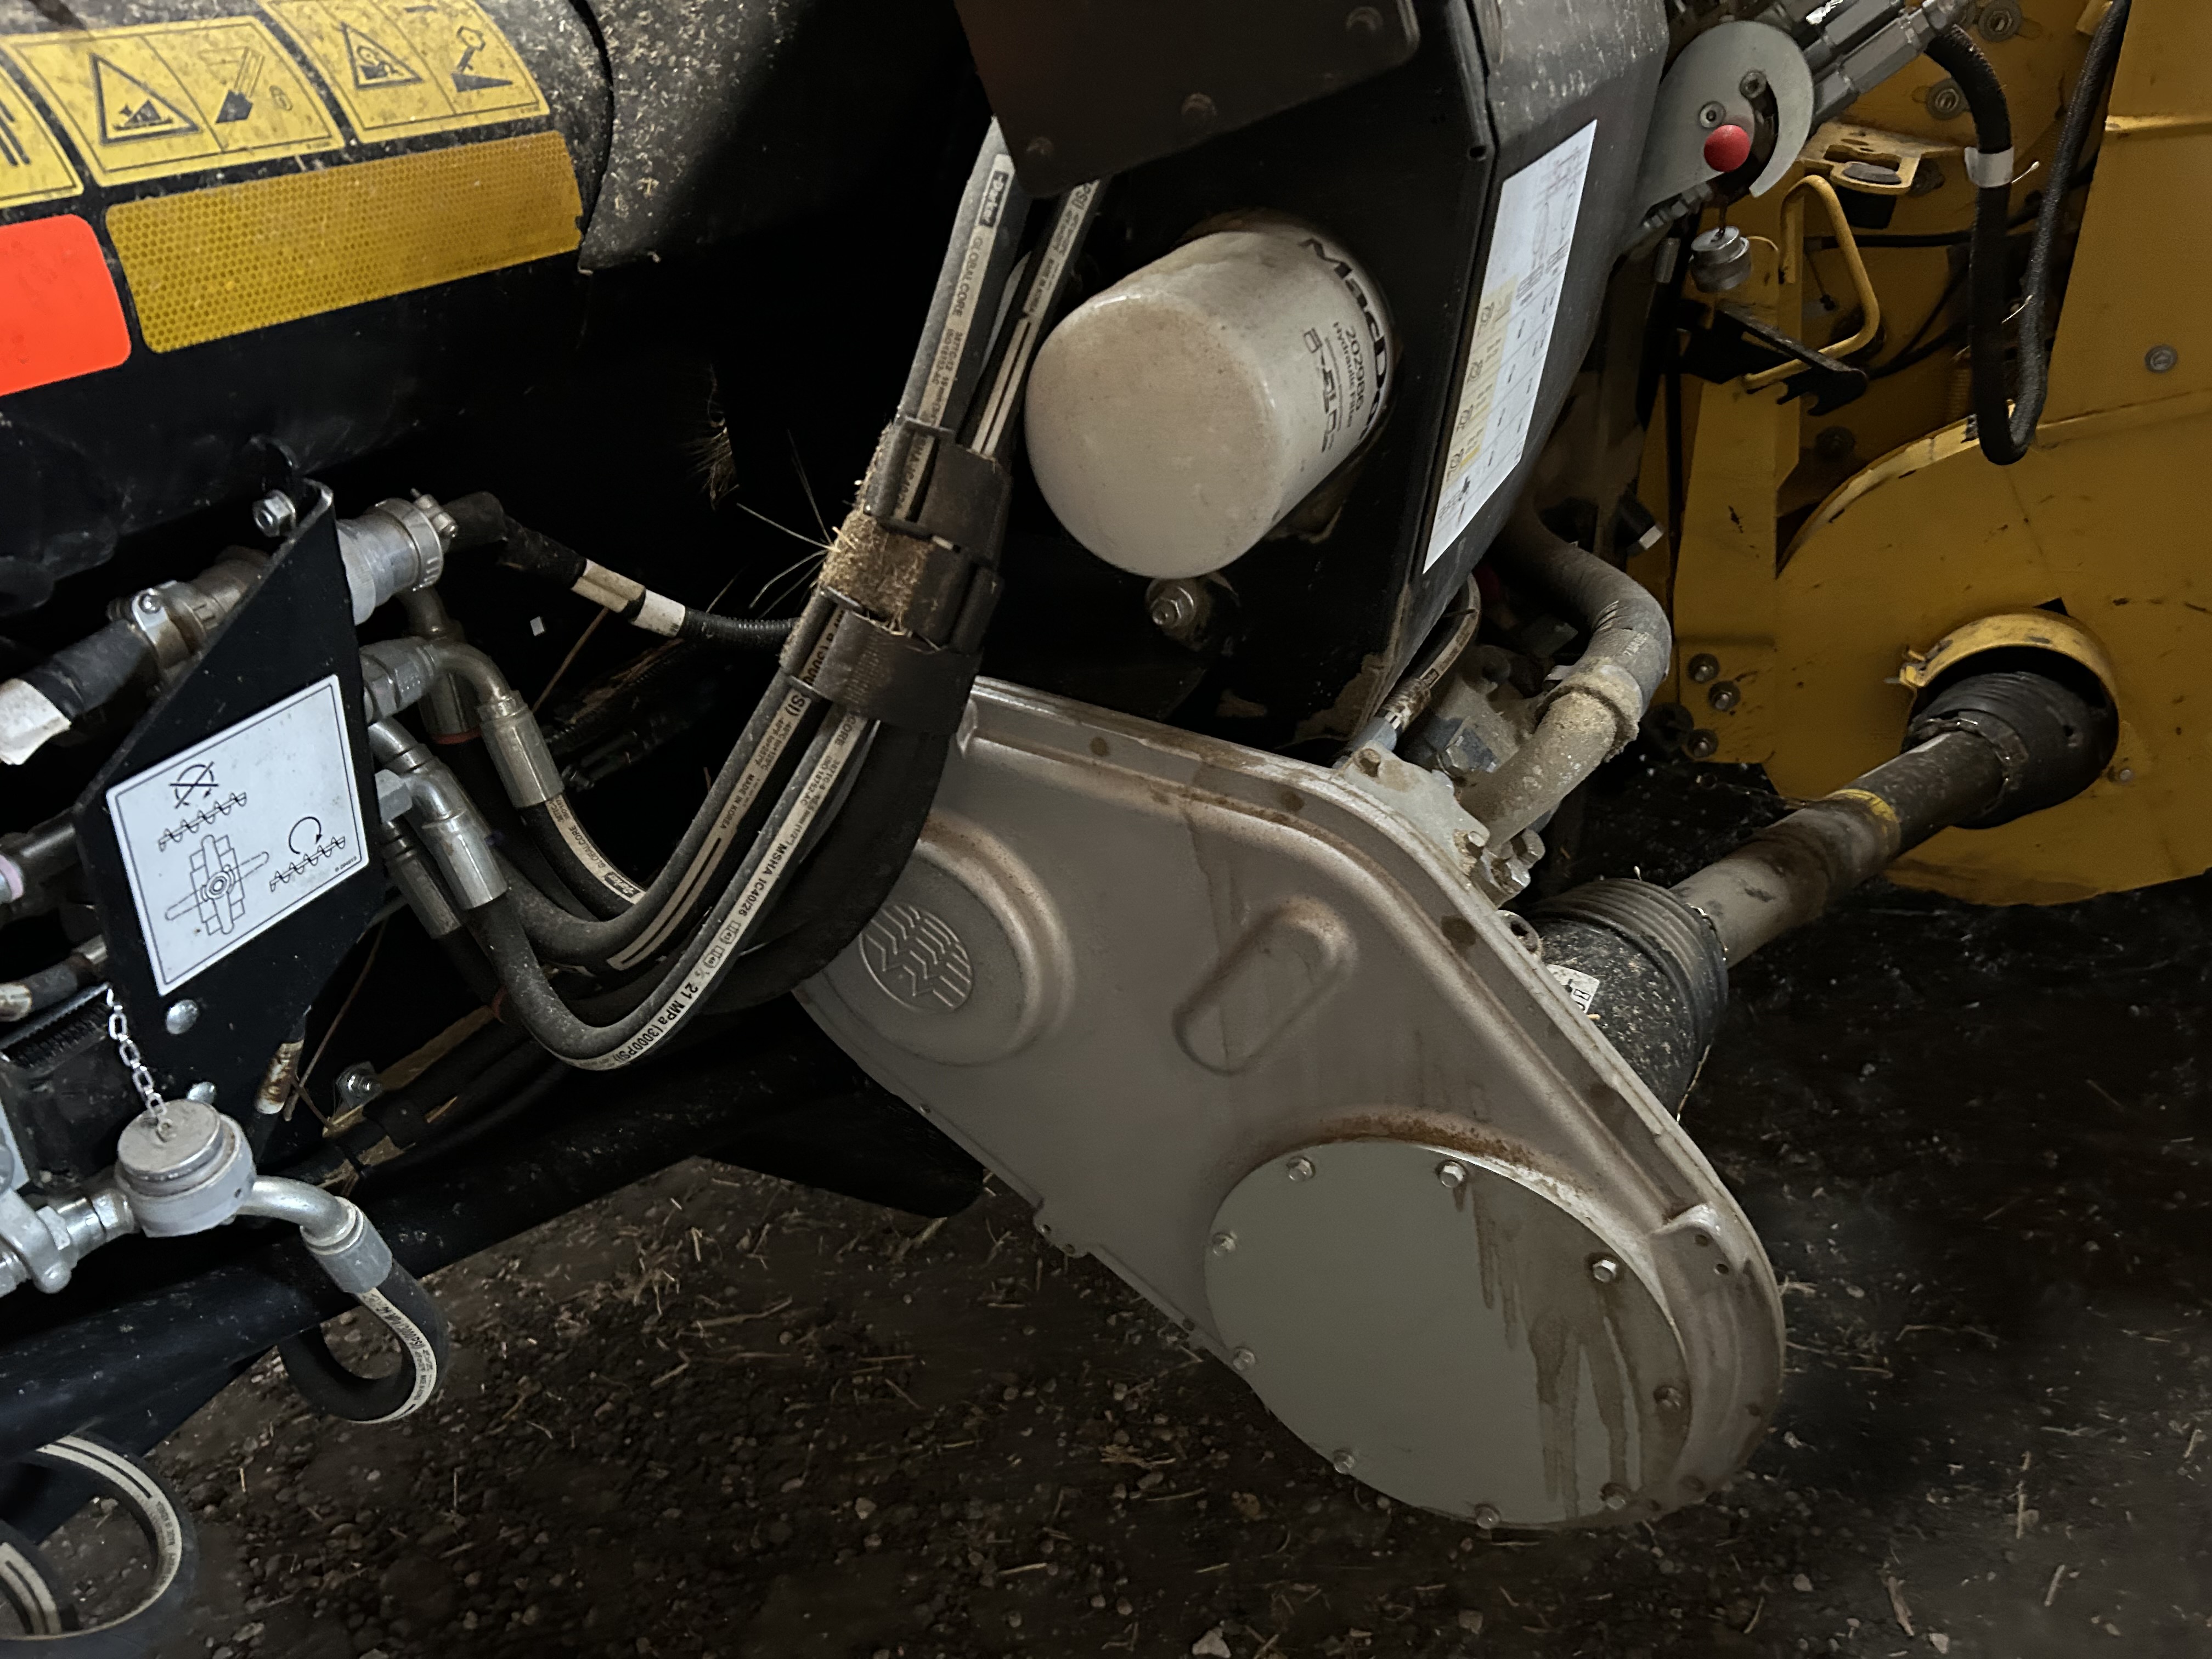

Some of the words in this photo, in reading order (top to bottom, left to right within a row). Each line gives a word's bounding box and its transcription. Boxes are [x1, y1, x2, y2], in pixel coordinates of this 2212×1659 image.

[981, 173, 1006, 224] Parker
[1333, 321, 1356, 389] Hydraulic
[835, 715, 857, 747] CORE
[733, 794, 743, 805] IN
[739, 774, 755, 795] MADE
[719, 804, 738, 831] KOREA
[568, 825, 606, 869] GLOBALCORE
[762, 843, 788, 876] MSHA
[739, 878, 768, 916] IC40/26
[684, 982, 699, 1000] 21
[658, 1000, 686, 1025] MPa
[614, 1024, 664, 1062] (3000PSI)
